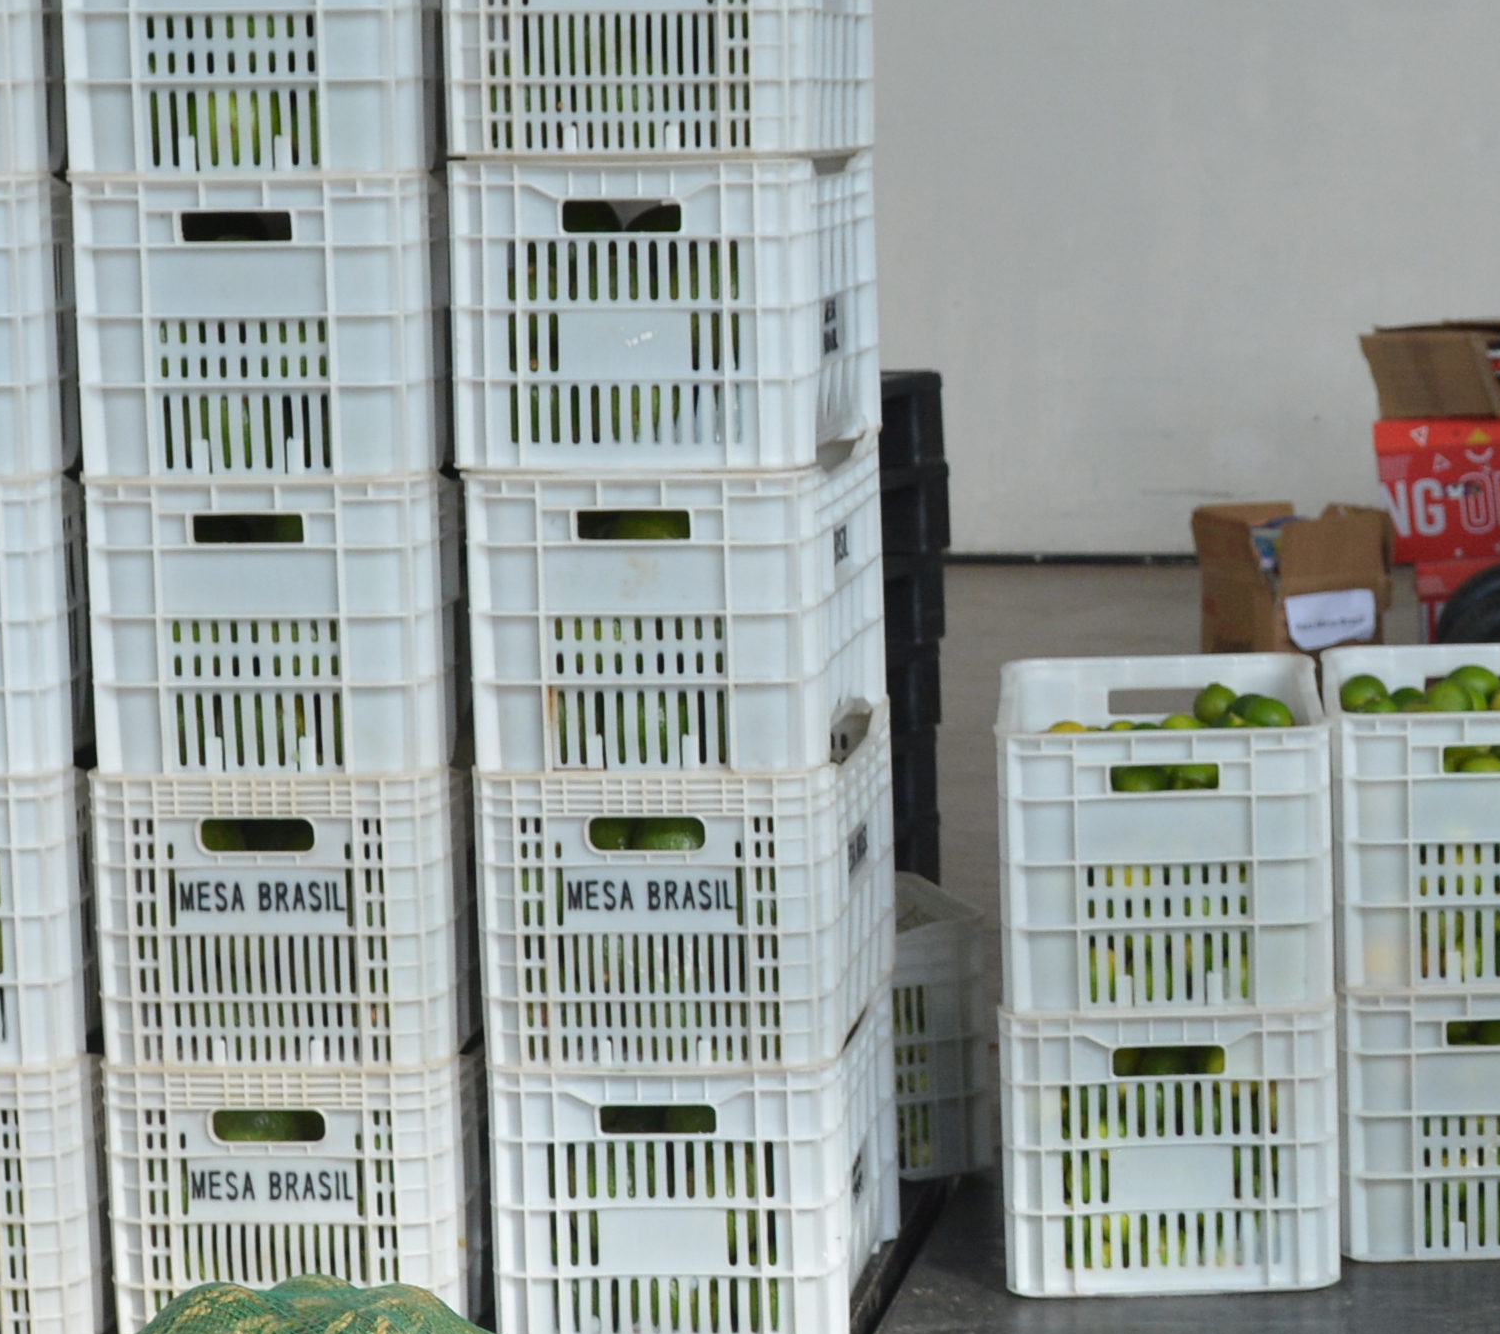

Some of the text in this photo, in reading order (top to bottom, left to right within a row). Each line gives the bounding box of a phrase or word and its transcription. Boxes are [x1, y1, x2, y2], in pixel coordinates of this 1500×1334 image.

[179, 880, 346, 913] MESA BRASIL
[567, 880, 736, 912] MESA BRASIL
[190, 1171, 353, 1202] MESA BRASIL
